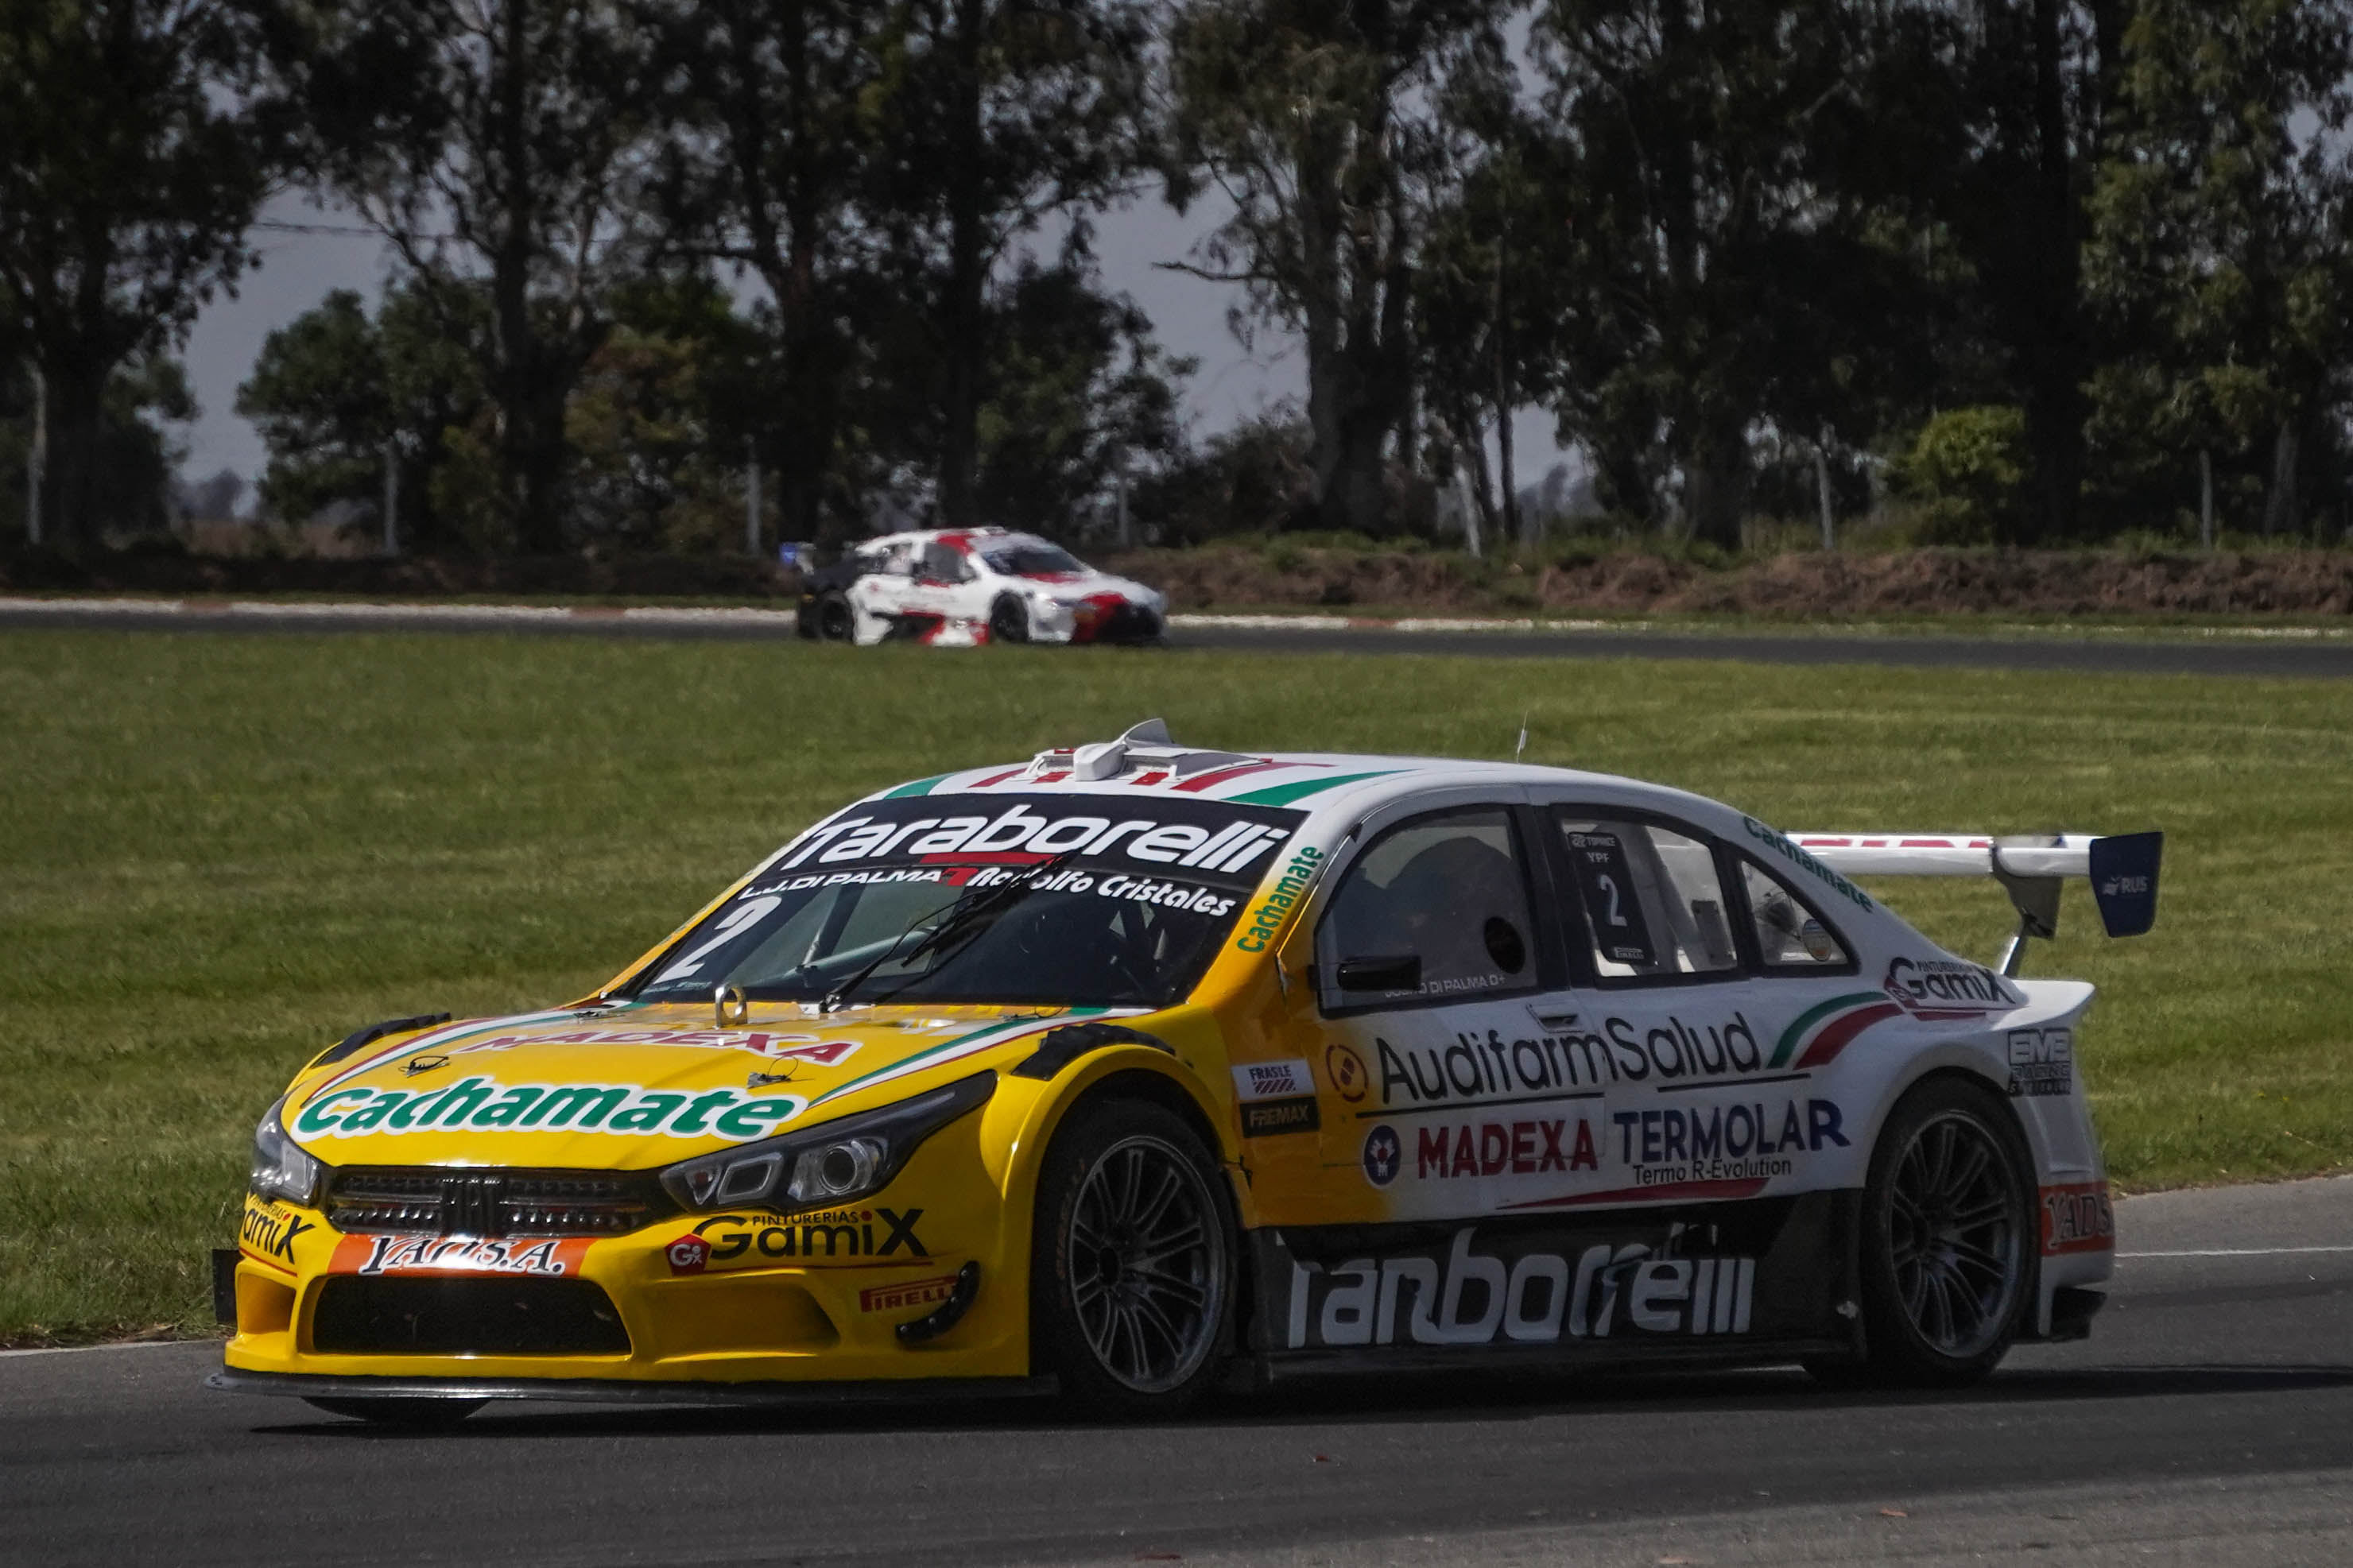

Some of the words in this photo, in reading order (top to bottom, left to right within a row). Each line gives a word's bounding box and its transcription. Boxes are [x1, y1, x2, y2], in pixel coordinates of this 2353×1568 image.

[781, 803, 1290, 875] Taraborelli
[1742, 815, 1874, 913] Cachamate
[821, 869, 942, 889] PALMA
[966, 866, 1094, 894] Roolfo
[1097, 876, 1236, 917] Cristales
[1236, 846, 1324, 953] Cachamate
[1599, 873, 1629, 927] 2
[653, 894, 782, 985] 2
[452, 1031, 859, 1066] MADEXA
[294, 1077, 799, 1139] Cachamate
[1613, 1098, 1851, 1164] TERMOLAR
[1418, 1119, 1598, 1179] MADEXA
[1633, 1163, 1686, 1185] Termo
[1691, 1156, 1792, 1183] R-Evolution
[752, 1210, 859, 1226] PINTURERIAS
